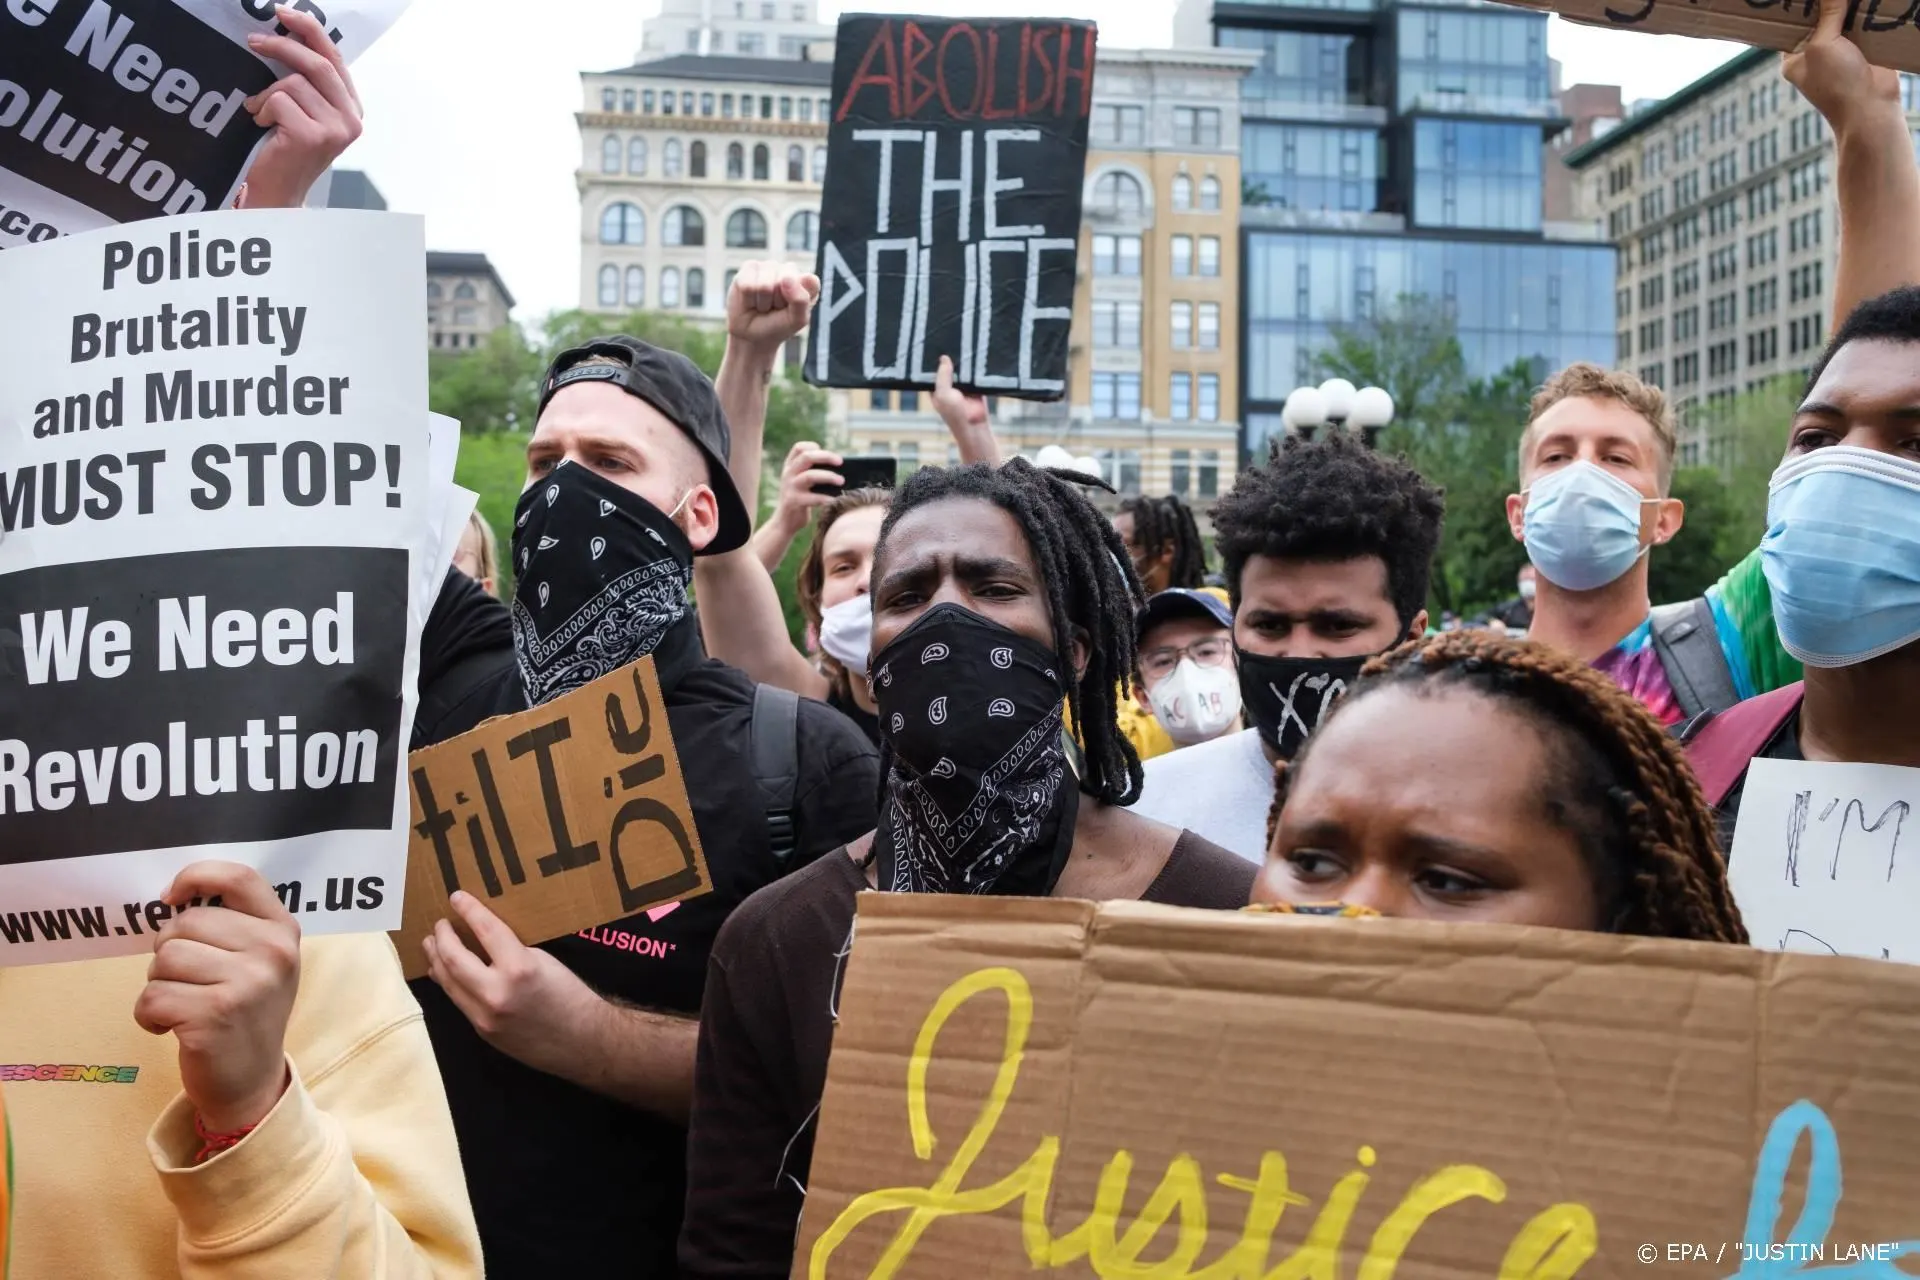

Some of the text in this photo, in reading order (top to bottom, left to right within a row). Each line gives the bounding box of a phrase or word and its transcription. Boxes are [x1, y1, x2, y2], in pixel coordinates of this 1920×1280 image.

[64, 0, 247, 138] Need
[836, 19, 1096, 123] ABOLISH
[852, 129, 1046, 246] THE
[103, 229, 271, 290] Police
[71, 295, 307, 363] Brutality
[816, 237, 1076, 391] POLICE
[33, 365, 349, 438] and Murder
[0, 441, 401, 532] MUST STOP!
[20, 592, 354, 685] We Need
[0, 716, 378, 815] Revolution
[506, 717, 601, 877] I
[604, 668, 702, 912] Die
[1785, 790, 1910, 888] I'M
[810, 967, 1597, 1280] Justice
